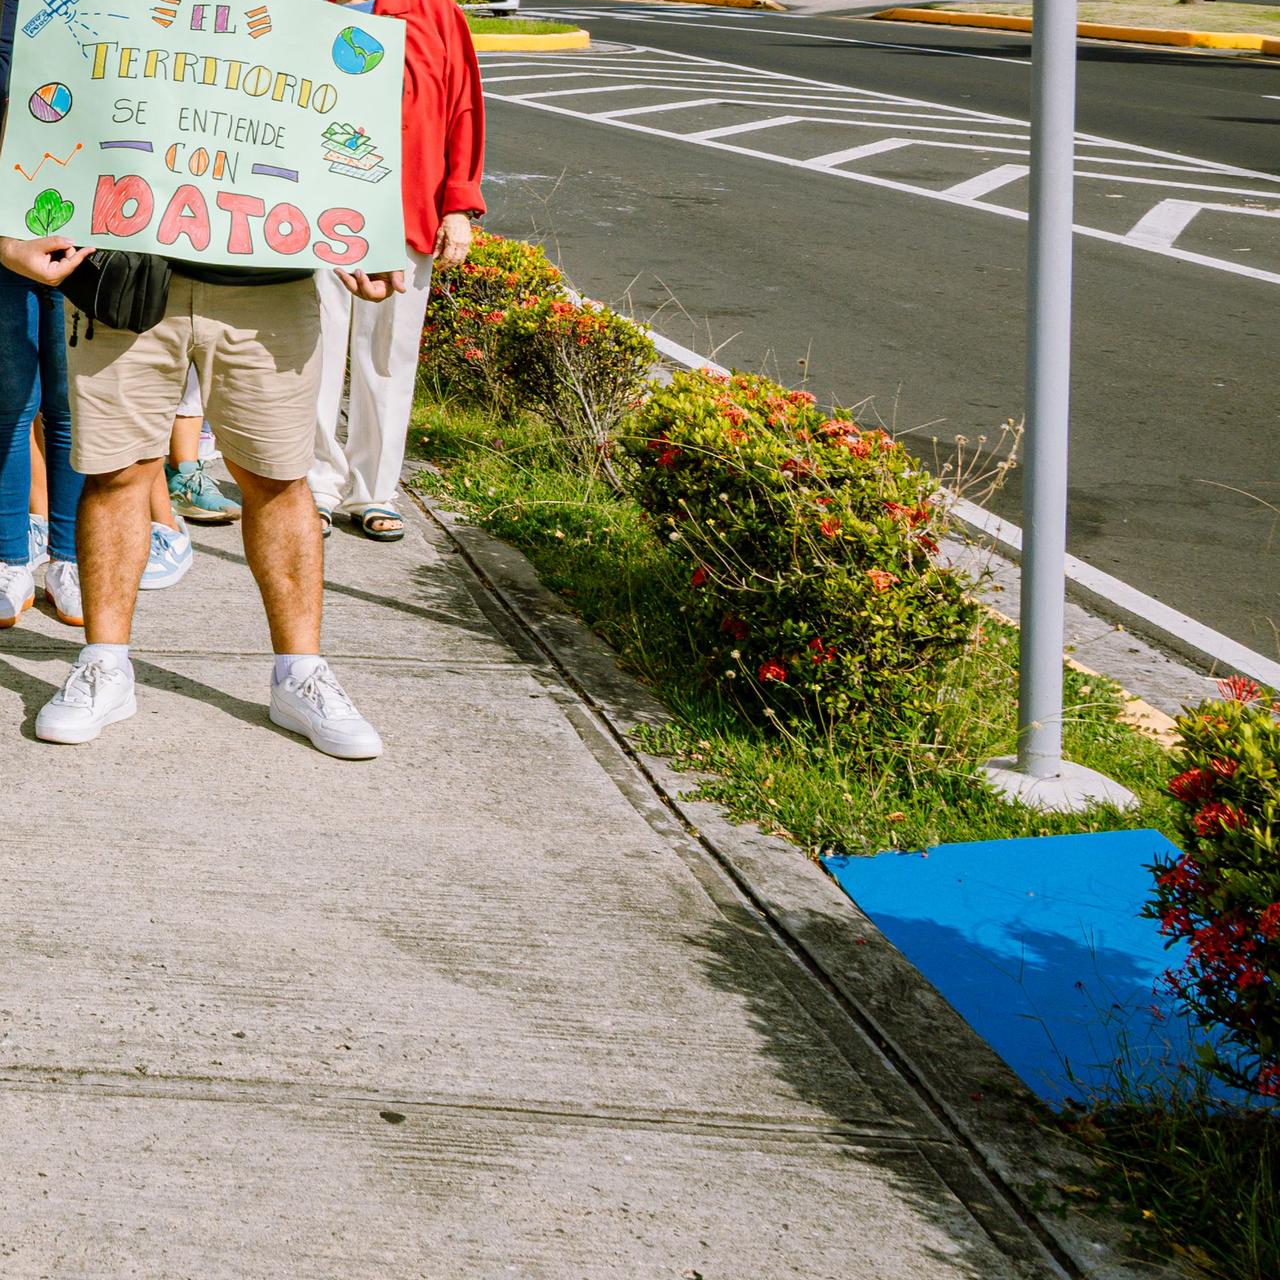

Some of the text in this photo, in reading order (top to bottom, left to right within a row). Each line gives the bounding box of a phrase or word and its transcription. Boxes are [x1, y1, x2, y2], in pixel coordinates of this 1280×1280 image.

[190, 4, 237, 34] EL
[82, 41, 338, 114] TERRITORIO
[112, 98, 287, 149] SE ENTIENDE
[165, 142, 239, 185] CON
[90, 174, 369, 265] DATOS
